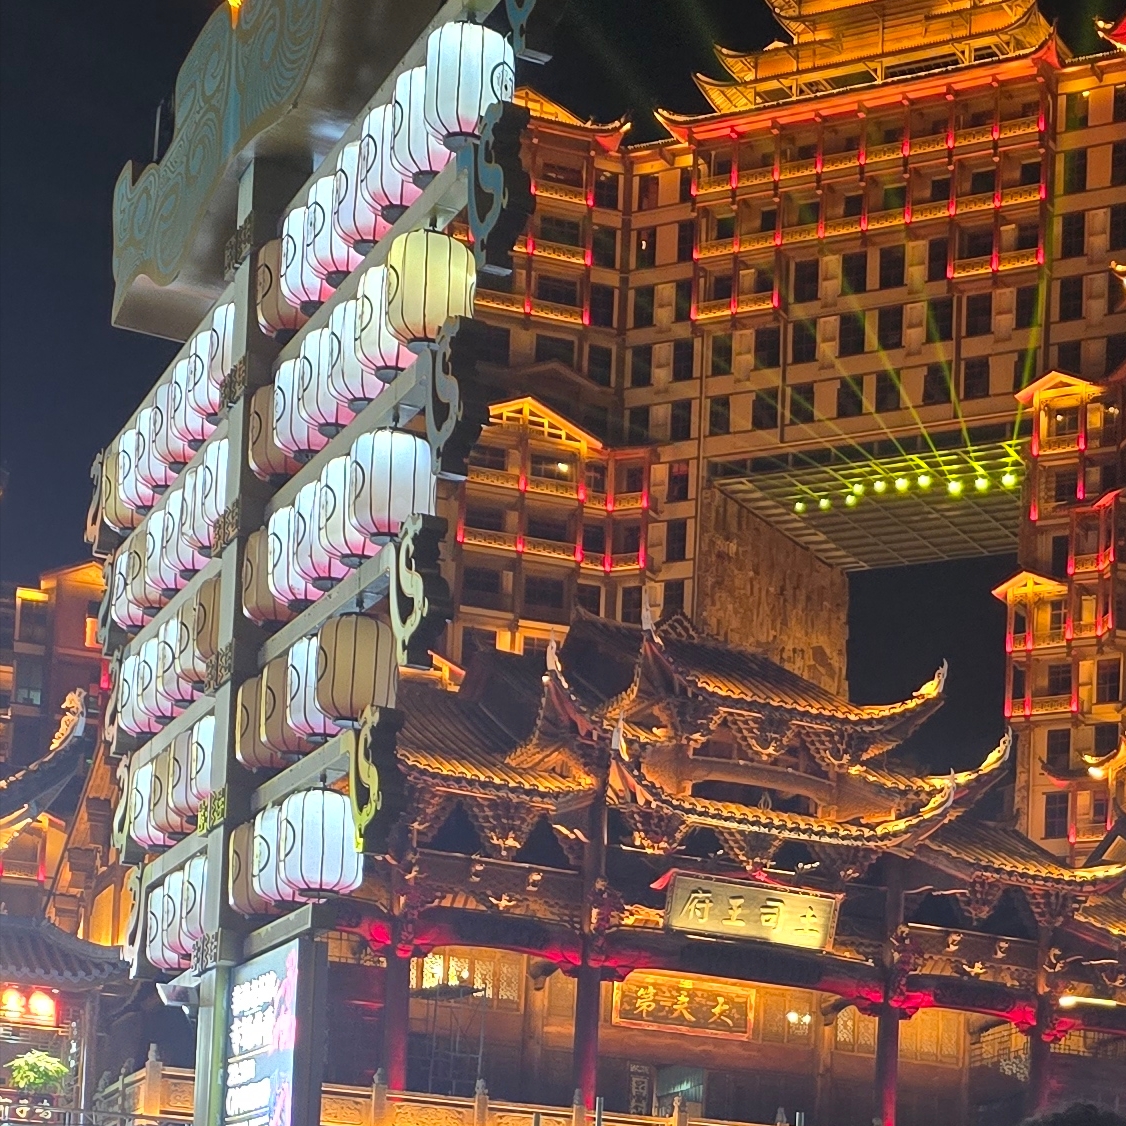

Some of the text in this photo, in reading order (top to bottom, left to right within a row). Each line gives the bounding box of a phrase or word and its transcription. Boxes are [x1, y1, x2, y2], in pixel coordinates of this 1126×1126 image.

[678, 886, 821, 934] 土司王府
[634, 985, 734, 1028] 大夫第
